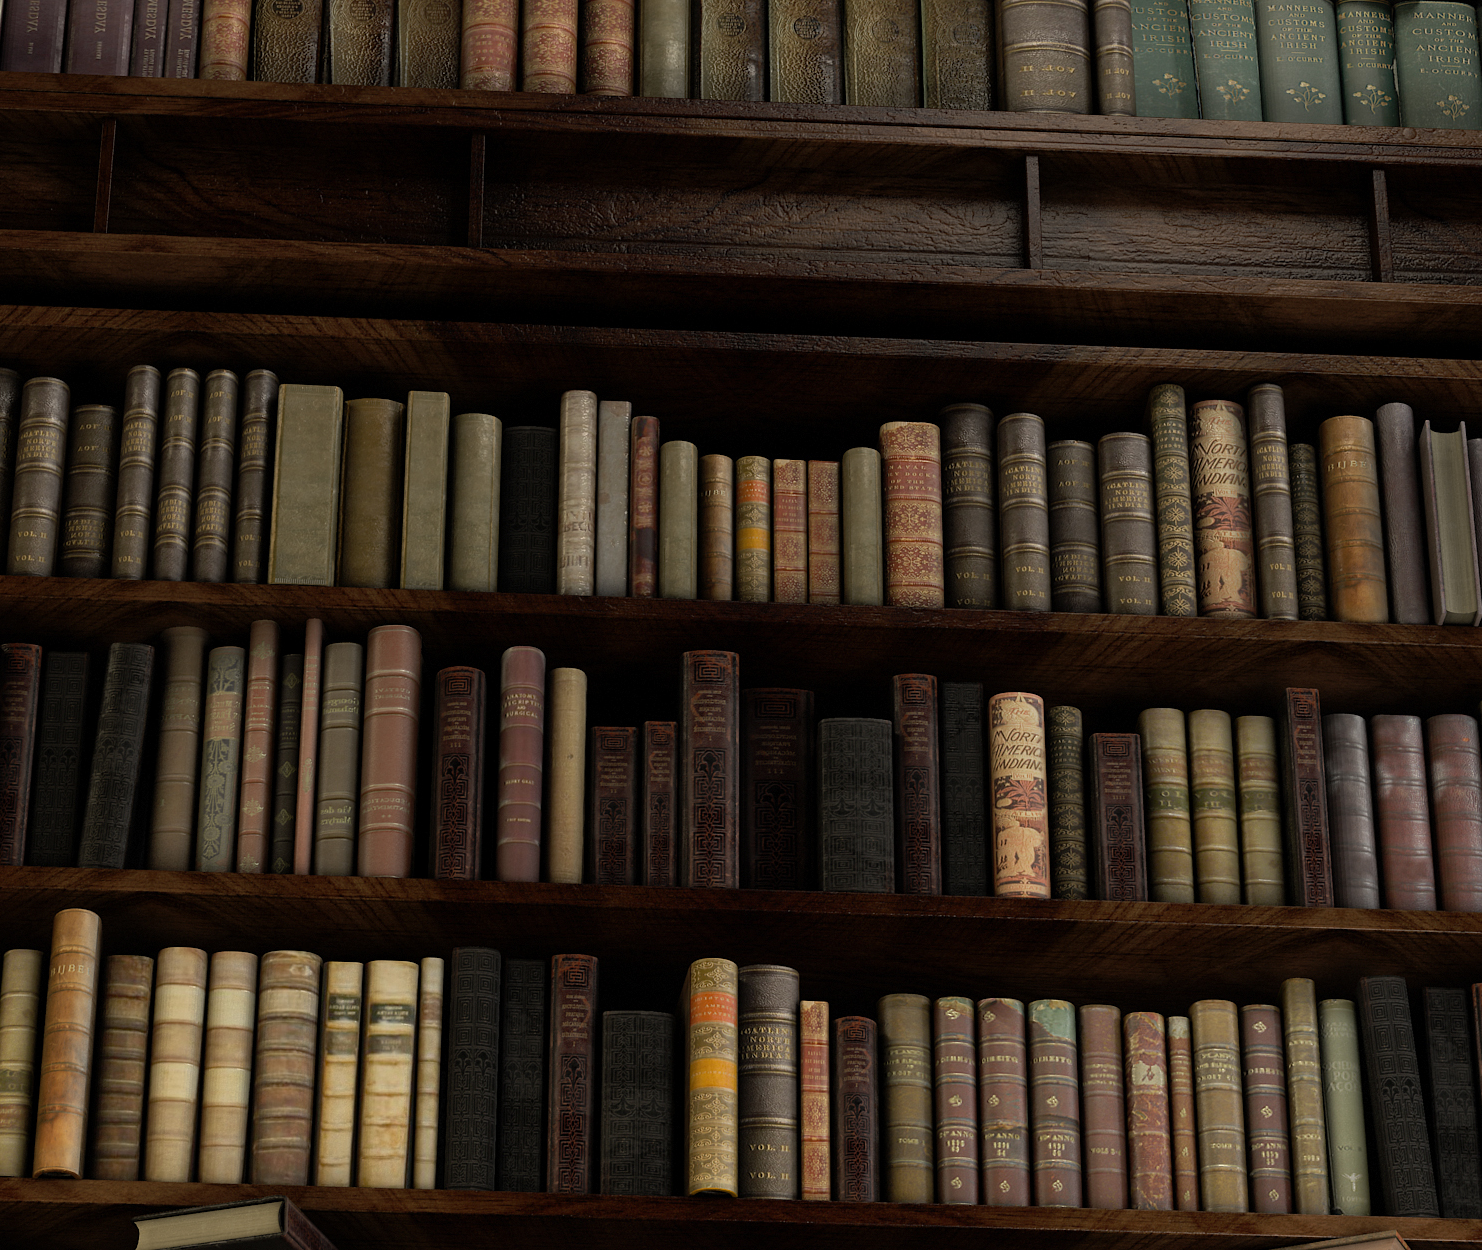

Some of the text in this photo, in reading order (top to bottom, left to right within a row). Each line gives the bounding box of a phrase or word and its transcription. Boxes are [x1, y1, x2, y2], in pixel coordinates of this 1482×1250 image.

[1268, 4, 1324, 14] MANNERS
[1338, 11, 1391, 21] MANNERS
[1268, 18, 1326, 28] CUSTOMS
[1339, 25, 1393, 35] CUSTOMS
[1270, 32, 1326, 42] ANCIENT
[1280, 42, 1317, 50] IRISH
[1340, 40, 1393, 49] ANCIENT
[1349, 48, 1386, 57] IRISH
[1288, 56, 1324, 64] O'CURRY
[1428, 55, 1471, 65] IRISH
[1357, 62, 1393, 71] O'CURRY
